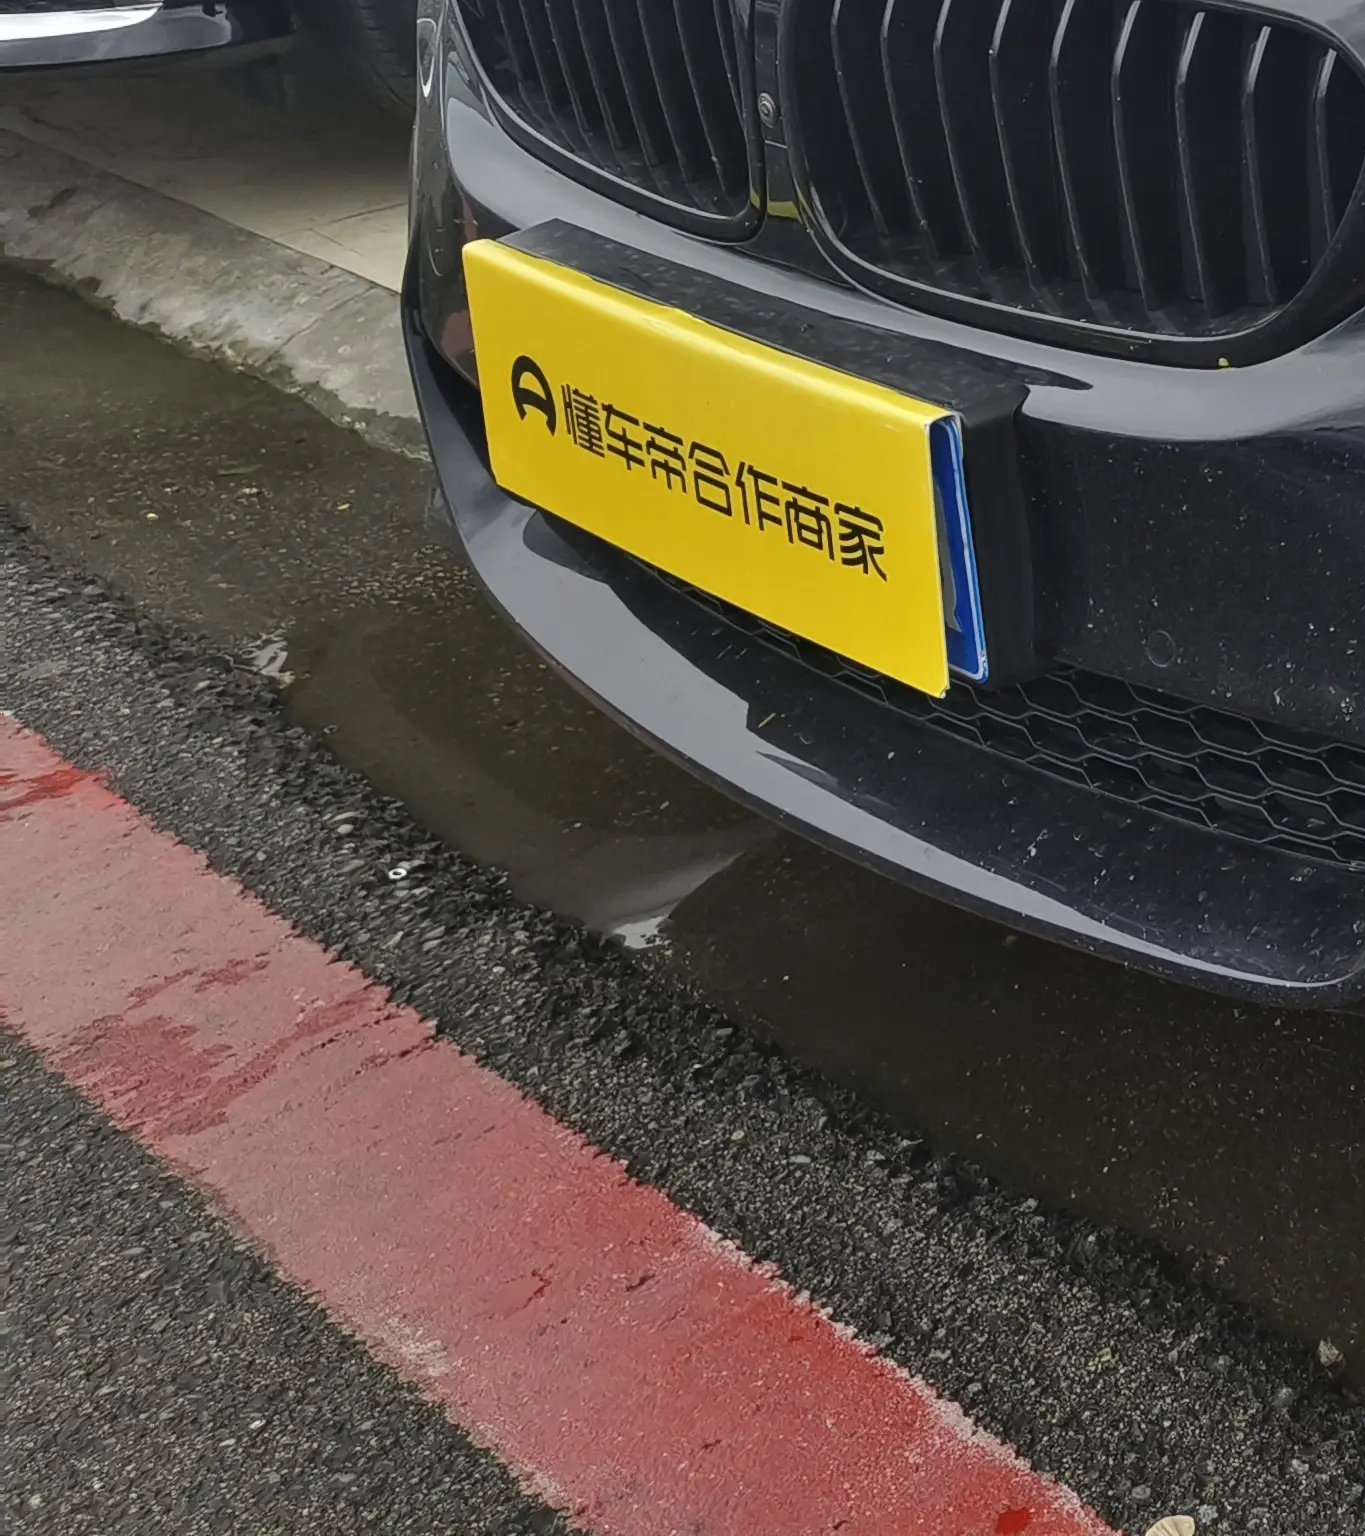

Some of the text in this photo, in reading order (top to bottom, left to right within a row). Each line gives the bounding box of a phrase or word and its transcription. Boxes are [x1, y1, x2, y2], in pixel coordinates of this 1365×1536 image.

[560, 383, 888, 583] 懂车帝合作商家
